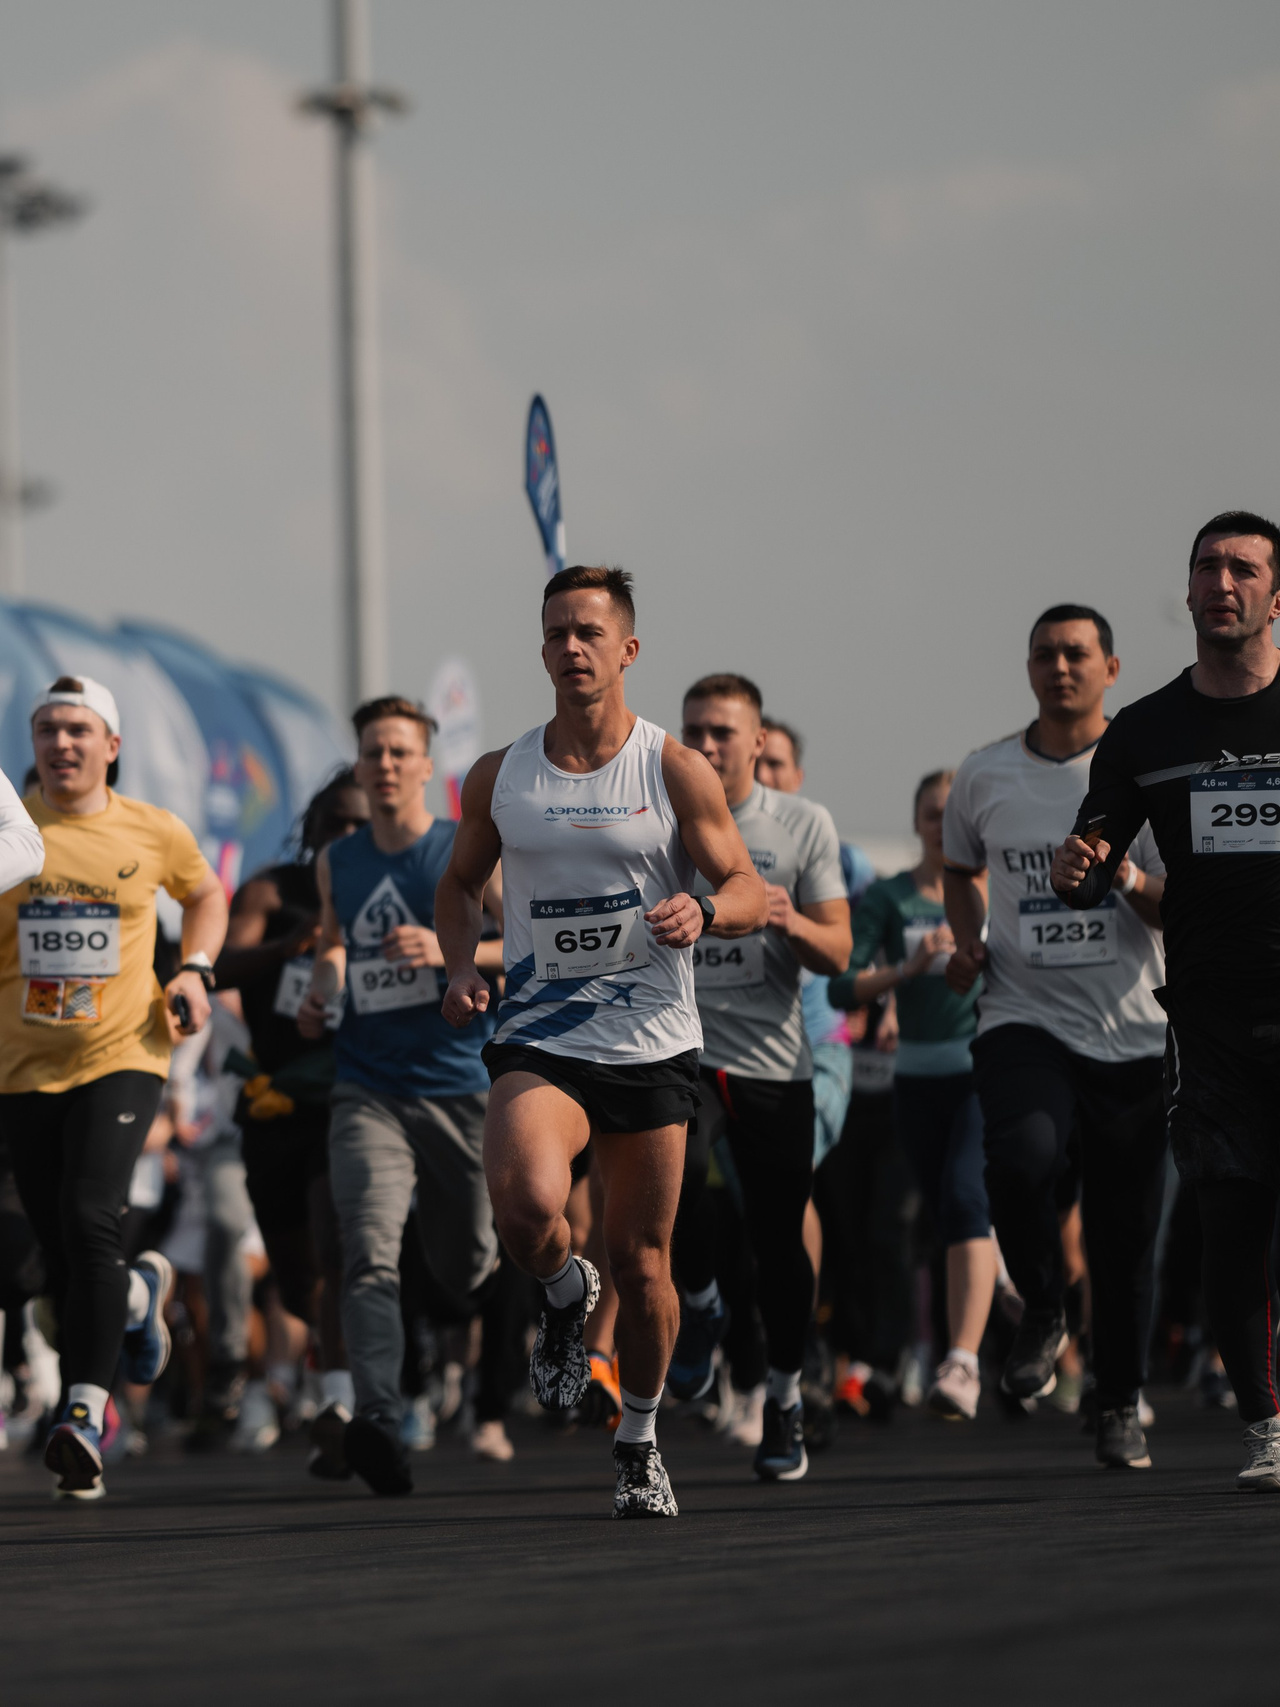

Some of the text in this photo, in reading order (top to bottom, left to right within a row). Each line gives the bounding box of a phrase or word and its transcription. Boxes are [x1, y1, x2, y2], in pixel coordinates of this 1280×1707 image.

[1202, 779, 1216, 788] 4,6
[544, 807, 630, 815] АЭРОФЛОТ
[1211, 803, 1280, 827] 299
[30, 881, 116, 900] МАРАФОН
[540, 906, 553, 915] 4,6
[604, 900, 618, 909] 4,6
[28, 930, 109, 952] 1890
[554, 924, 622, 954] 657
[1032, 920, 1106, 945] 1232
[362, 966, 416, 992] 920
